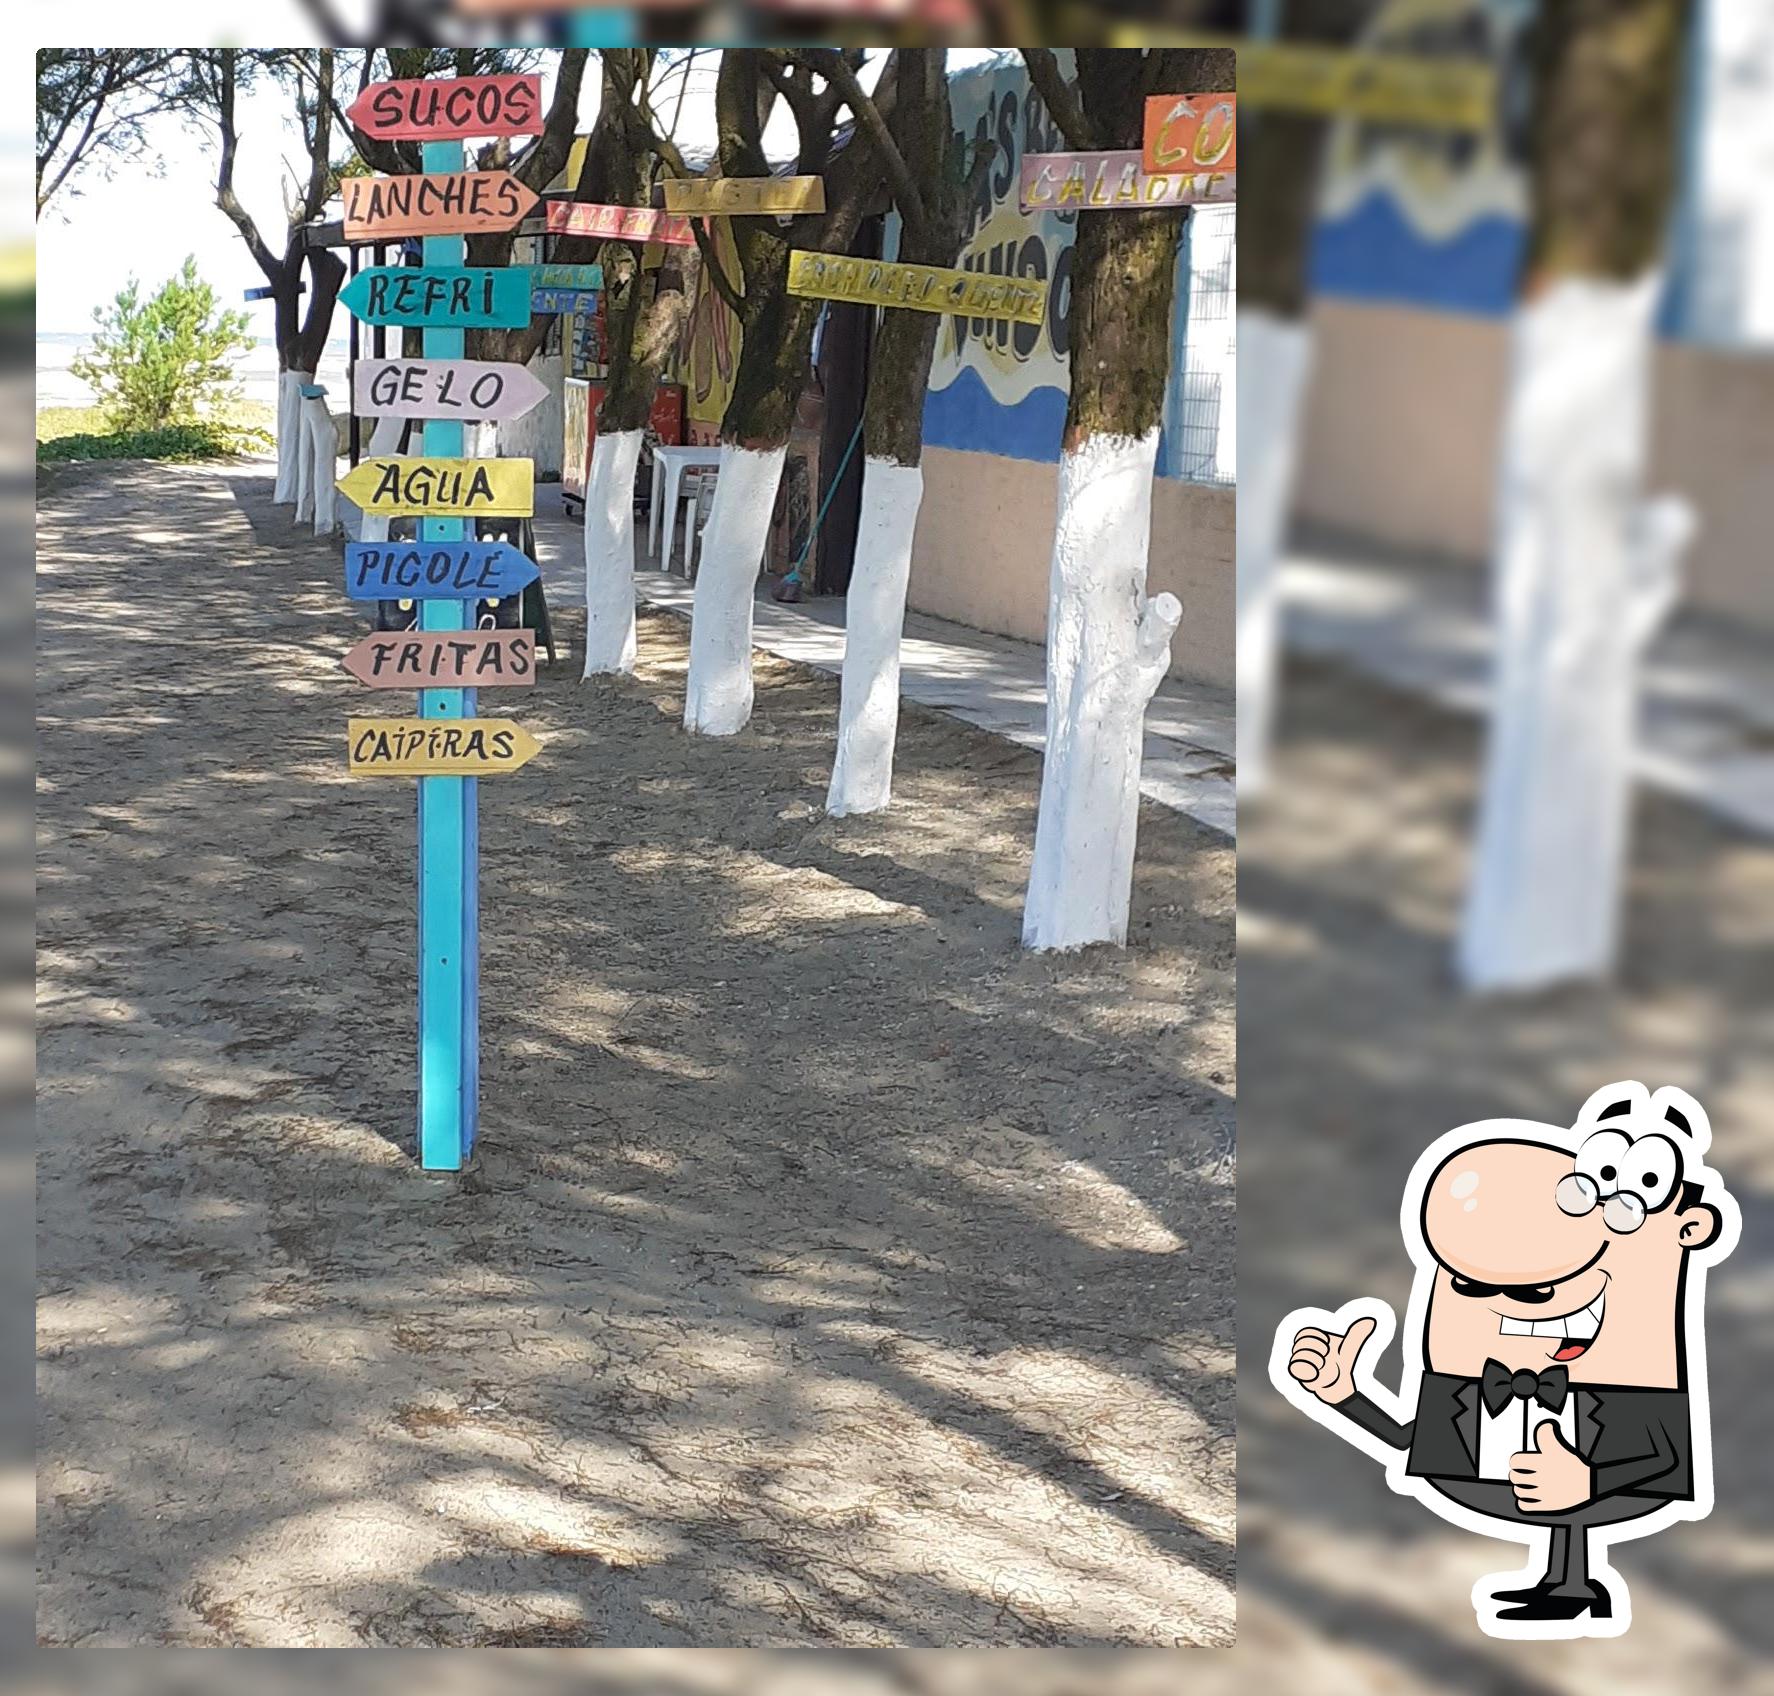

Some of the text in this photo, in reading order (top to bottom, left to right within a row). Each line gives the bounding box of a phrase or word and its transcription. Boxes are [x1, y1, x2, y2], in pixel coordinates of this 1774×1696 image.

[373, 81, 536, 128] SUCOS
[348, 177, 521, 224] LANCHES
[370, 366, 503, 409] GELO
[370, 638, 529, 676] FRITAS
